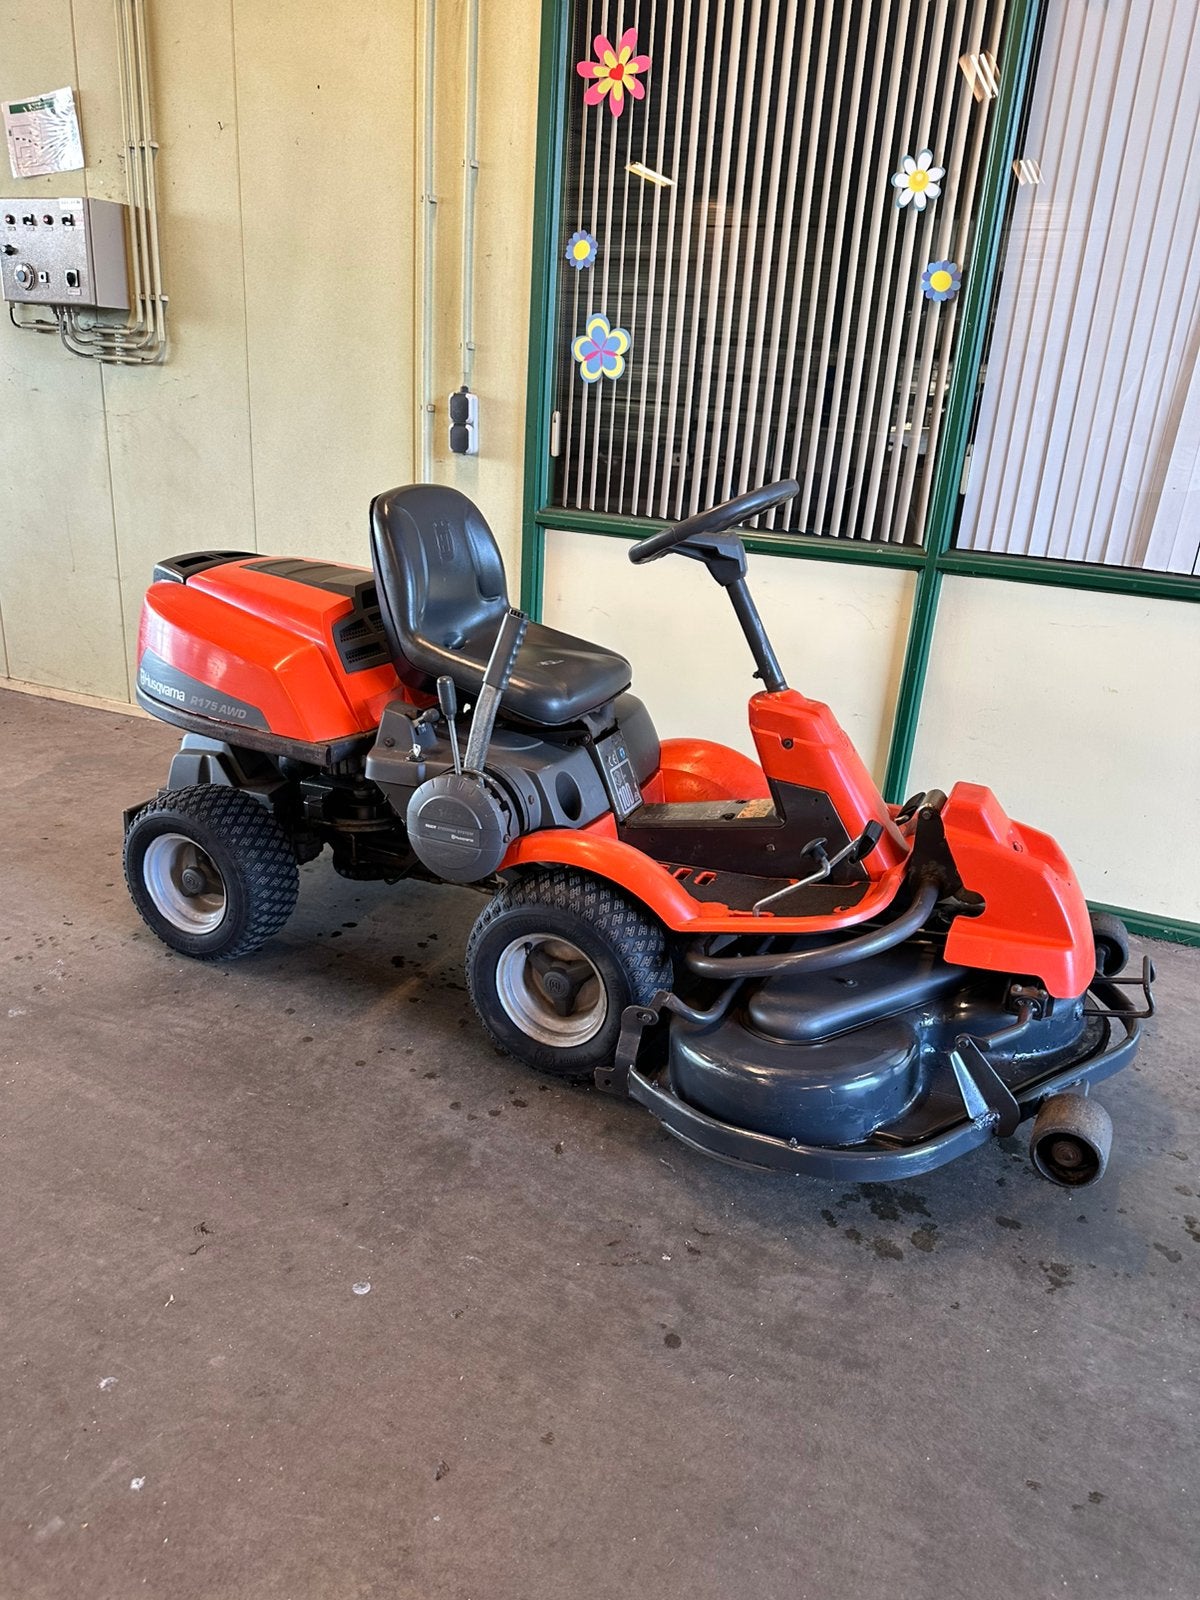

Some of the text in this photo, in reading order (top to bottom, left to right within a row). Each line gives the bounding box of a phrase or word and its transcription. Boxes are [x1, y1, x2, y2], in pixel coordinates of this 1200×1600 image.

[144, 671, 185, 702] Husqvarna
[190, 695, 247, 719] R175 AWD
[619, 782, 635, 810] 100
